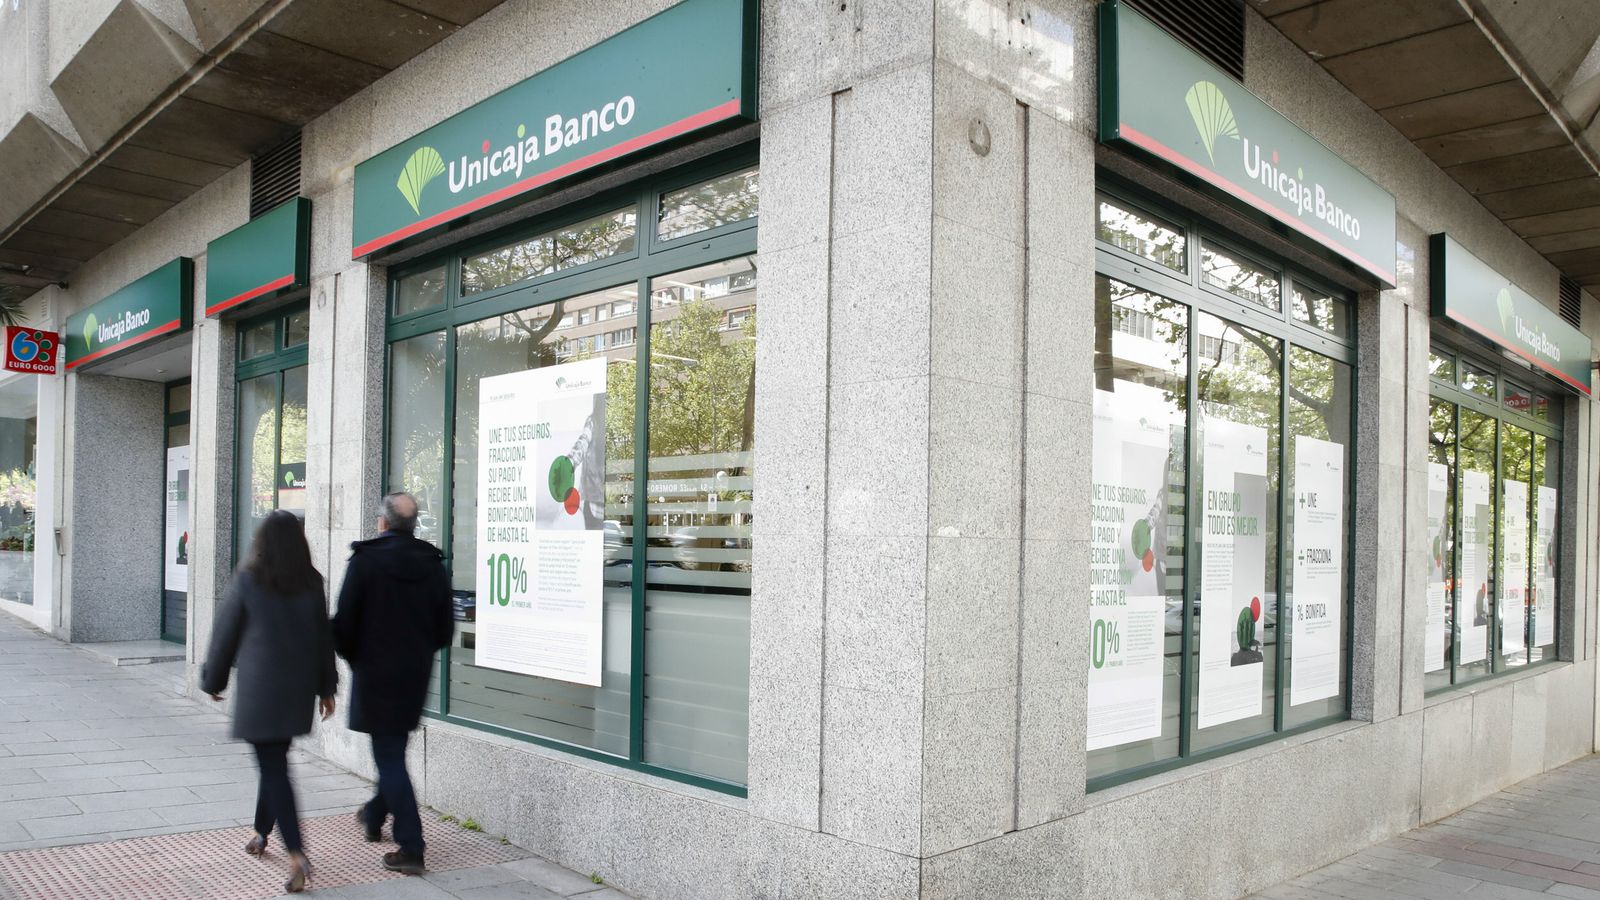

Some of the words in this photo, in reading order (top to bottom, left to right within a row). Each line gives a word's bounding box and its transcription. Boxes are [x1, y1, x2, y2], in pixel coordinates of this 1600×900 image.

[448, 124, 540, 193] Unicaja
[544, 95, 635, 155] Banco
[1243, 138, 1313, 216] Unicaja
[1315, 183, 1360, 241] Banco
[98, 312, 125, 343] Unicaja
[125, 308, 150, 331] Banco
[1515, 315, 1541, 354] Unicaja
[1541, 333, 1561, 362] Banco
[9, 361, 31, 369] EURO
[32, 363, 55, 372] 6000
[489, 427, 502, 444] UNE
[504, 426, 517, 442] TUS
[488, 446, 526, 463] FRACCIONA
[488, 468, 496, 483] SU
[498, 467, 515, 483] PAGO
[517, 466, 522, 481] Y
[488, 487, 511, 502] RECIBE
[513, 486, 527, 502] UNA
[1093, 484, 1101, 501] NE
[1104, 485, 1116, 502] TUS
[1208, 490, 1217, 511] EN
[1219, 491, 1241, 512] GRUPO
[1090, 505, 1125, 523] RACCIONA
[1208, 515, 1225, 535] TODO
[1227, 516, 1235, 536] ES
[488, 527, 496, 542] DE
[497, 527, 519, 542] HASTA
[521, 527, 529, 543] EL
[1097, 527, 1115, 544] PAGO
[1091, 548, 1110, 564] ECIBE
[1112, 548, 1126, 564] UNA
[487, 553, 527, 607] 10%
[1096, 590, 1118, 606] HASTA
[1119, 590, 1126, 606] EL
[1090, 618, 1120, 669] 0%
